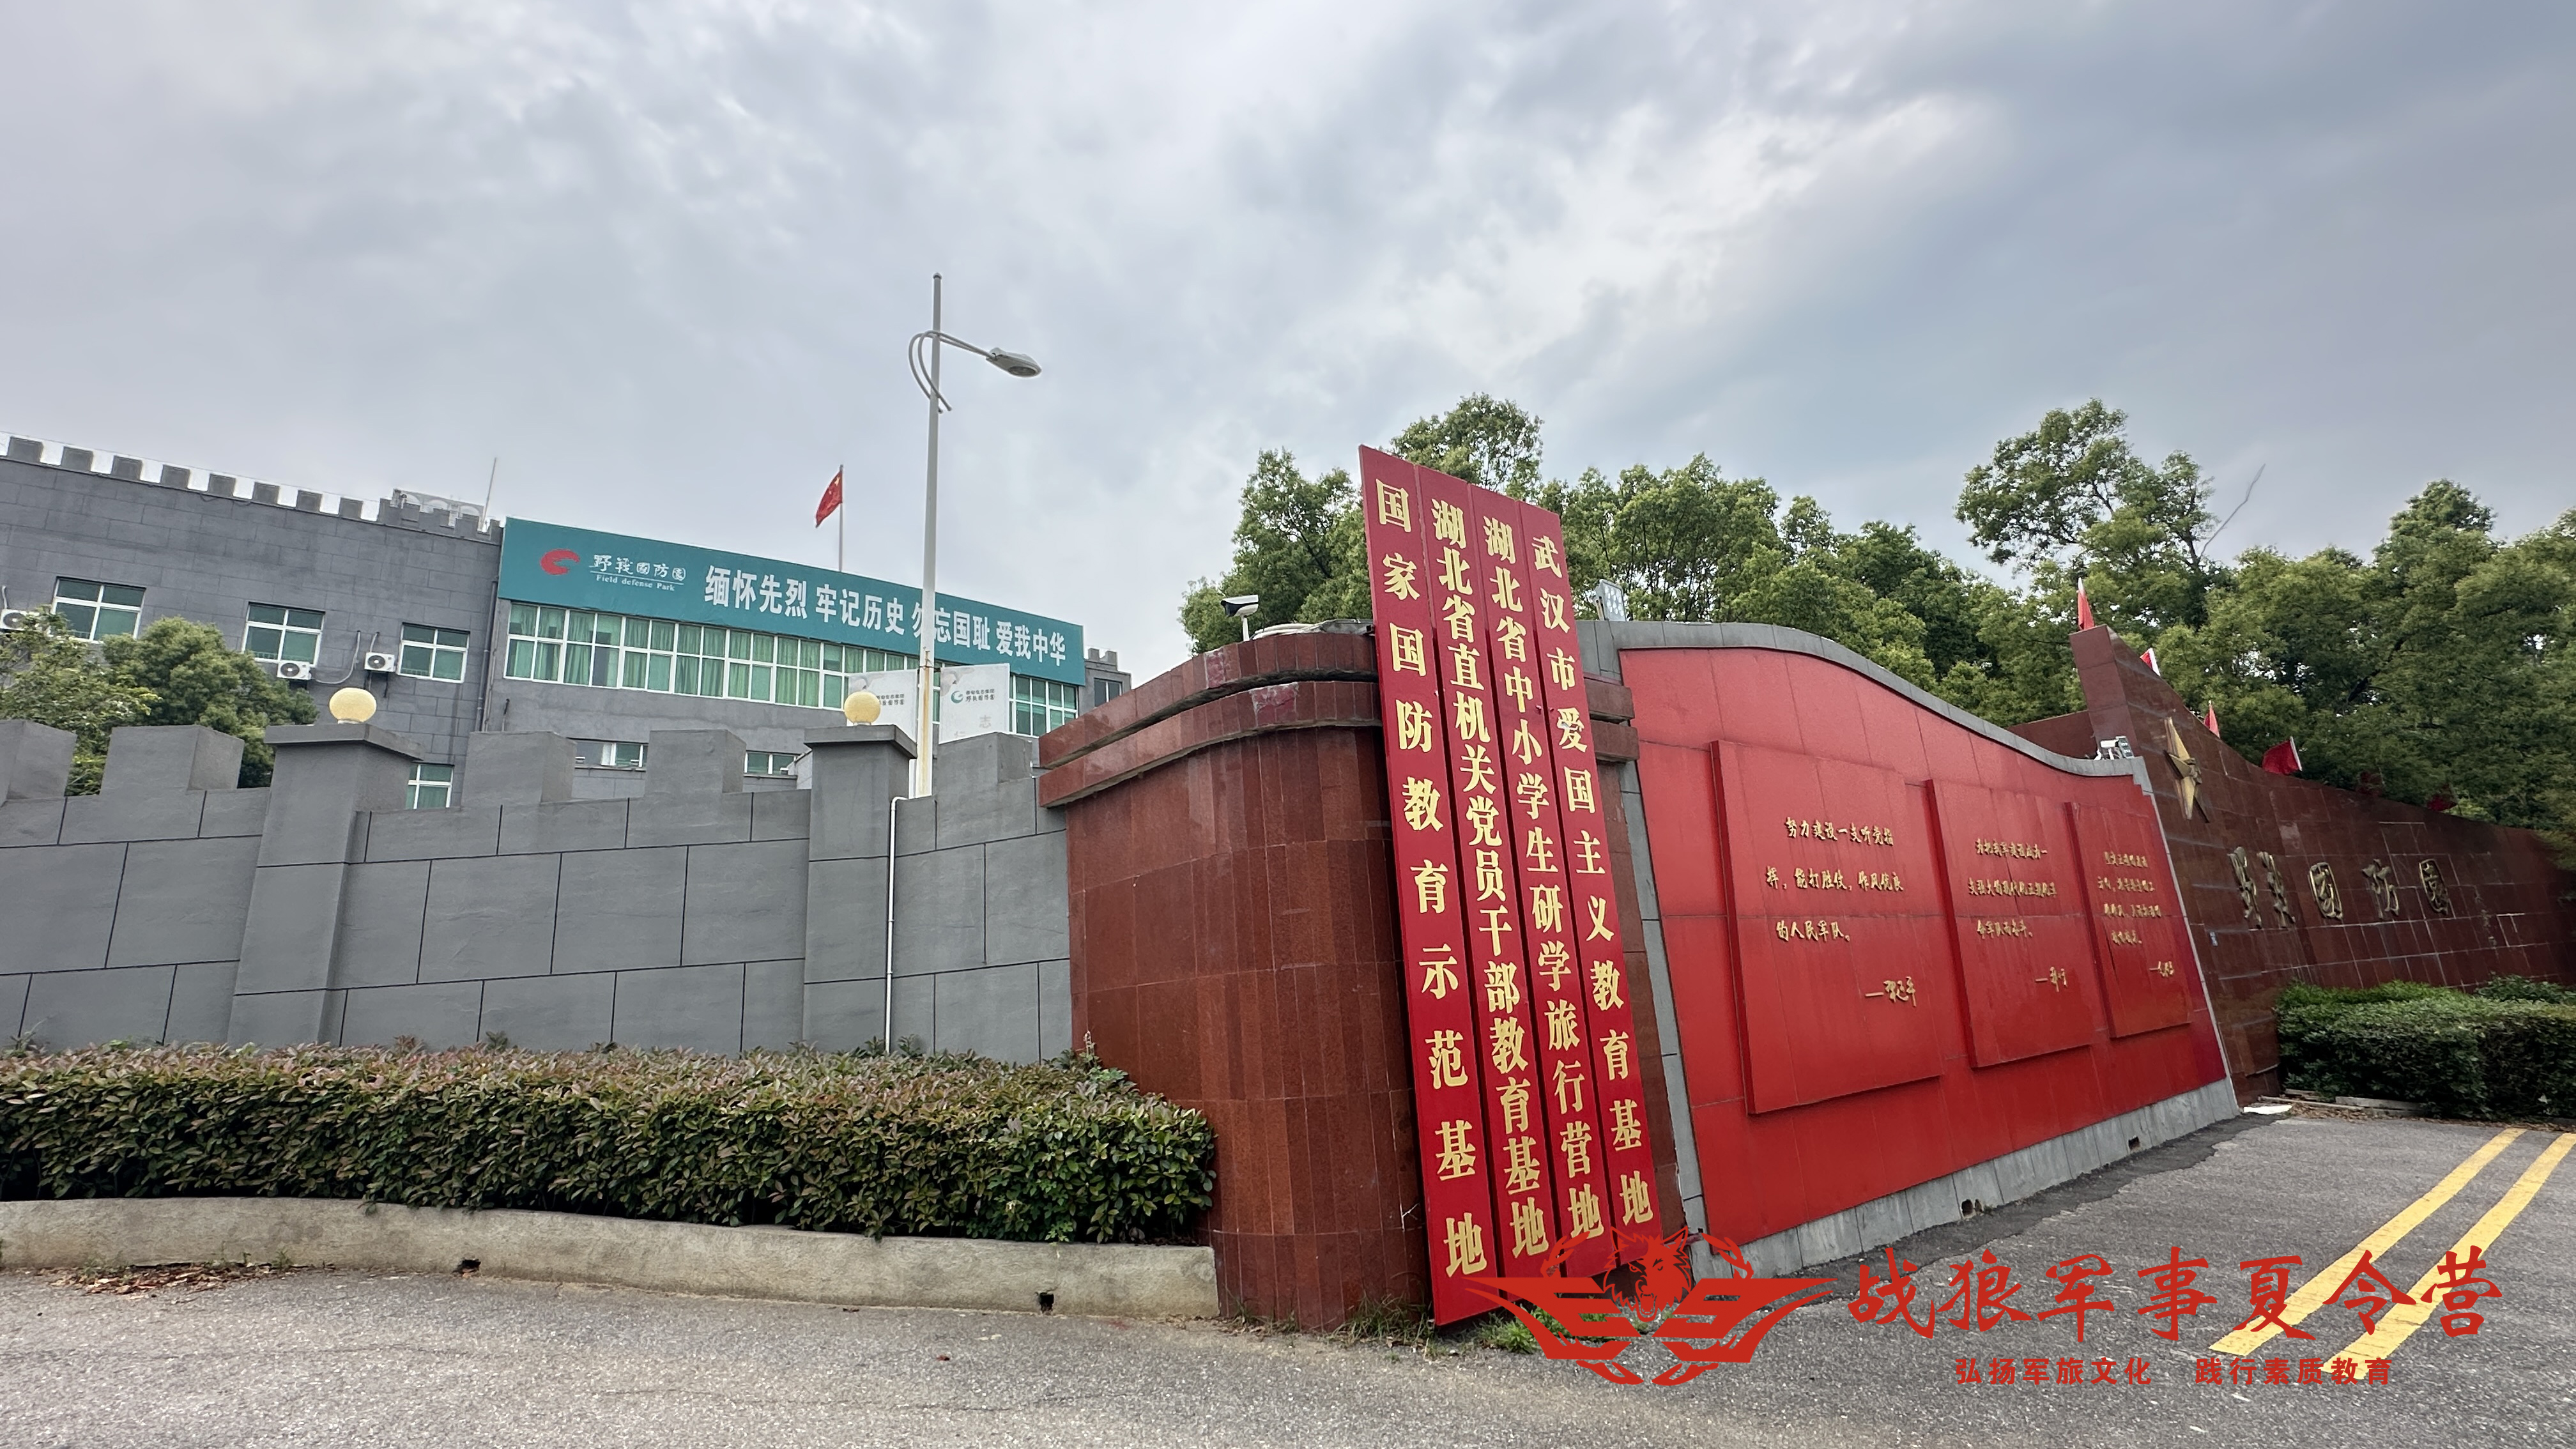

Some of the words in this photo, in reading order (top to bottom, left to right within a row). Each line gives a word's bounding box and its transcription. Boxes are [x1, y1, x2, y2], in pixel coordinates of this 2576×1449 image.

[596, 574, 618, 584] Field
[622, 578, 653, 588] defense
[656, 582, 675, 592] Park
[704, 565, 808, 619] 缅怀先烈
[815, 585, 905, 635] 牢记历史
[912, 602, 990, 650] 勿忘国耻
[995, 620, 1066, 666] 爱我中华
[1376, 479, 1487, 1278] 国家国防教育示范基地
[1431, 498, 1549, 1259] 湖北省直机关党员干部教育基地
[1482, 516, 1605, 1240] 湖北省中小学生研学旅行营地
[1531, 535, 1653, 1226] 武汉市爱国主义教育基地
[1785, 816, 1894, 846] 努力建设一支听党指
